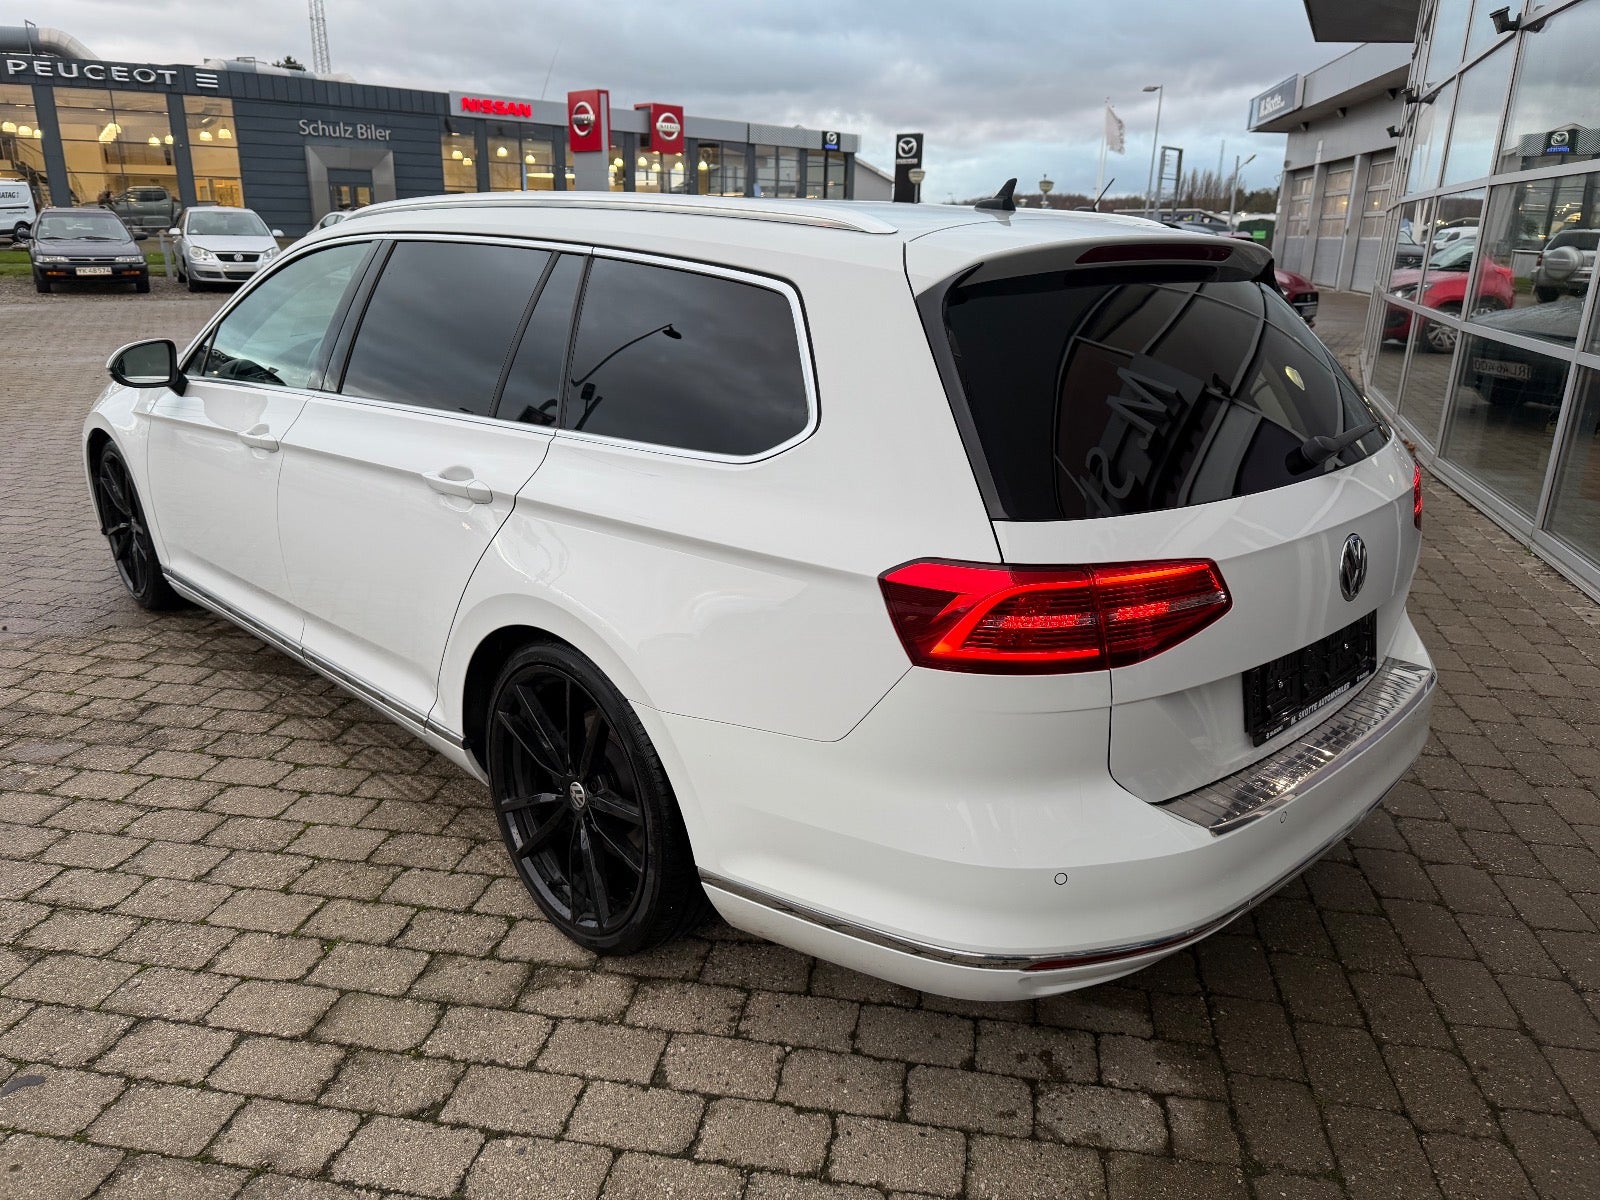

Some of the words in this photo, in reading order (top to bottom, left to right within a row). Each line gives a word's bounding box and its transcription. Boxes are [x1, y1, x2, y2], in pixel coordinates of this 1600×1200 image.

[6, 59, 177, 85] PEUGEOT
[461, 96, 532, 118] NISSAN
[299, 119, 353, 138] Schulz
[357, 123, 391, 140] Biler
[1317, 682, 1351, 708] AUTOMOBILER
